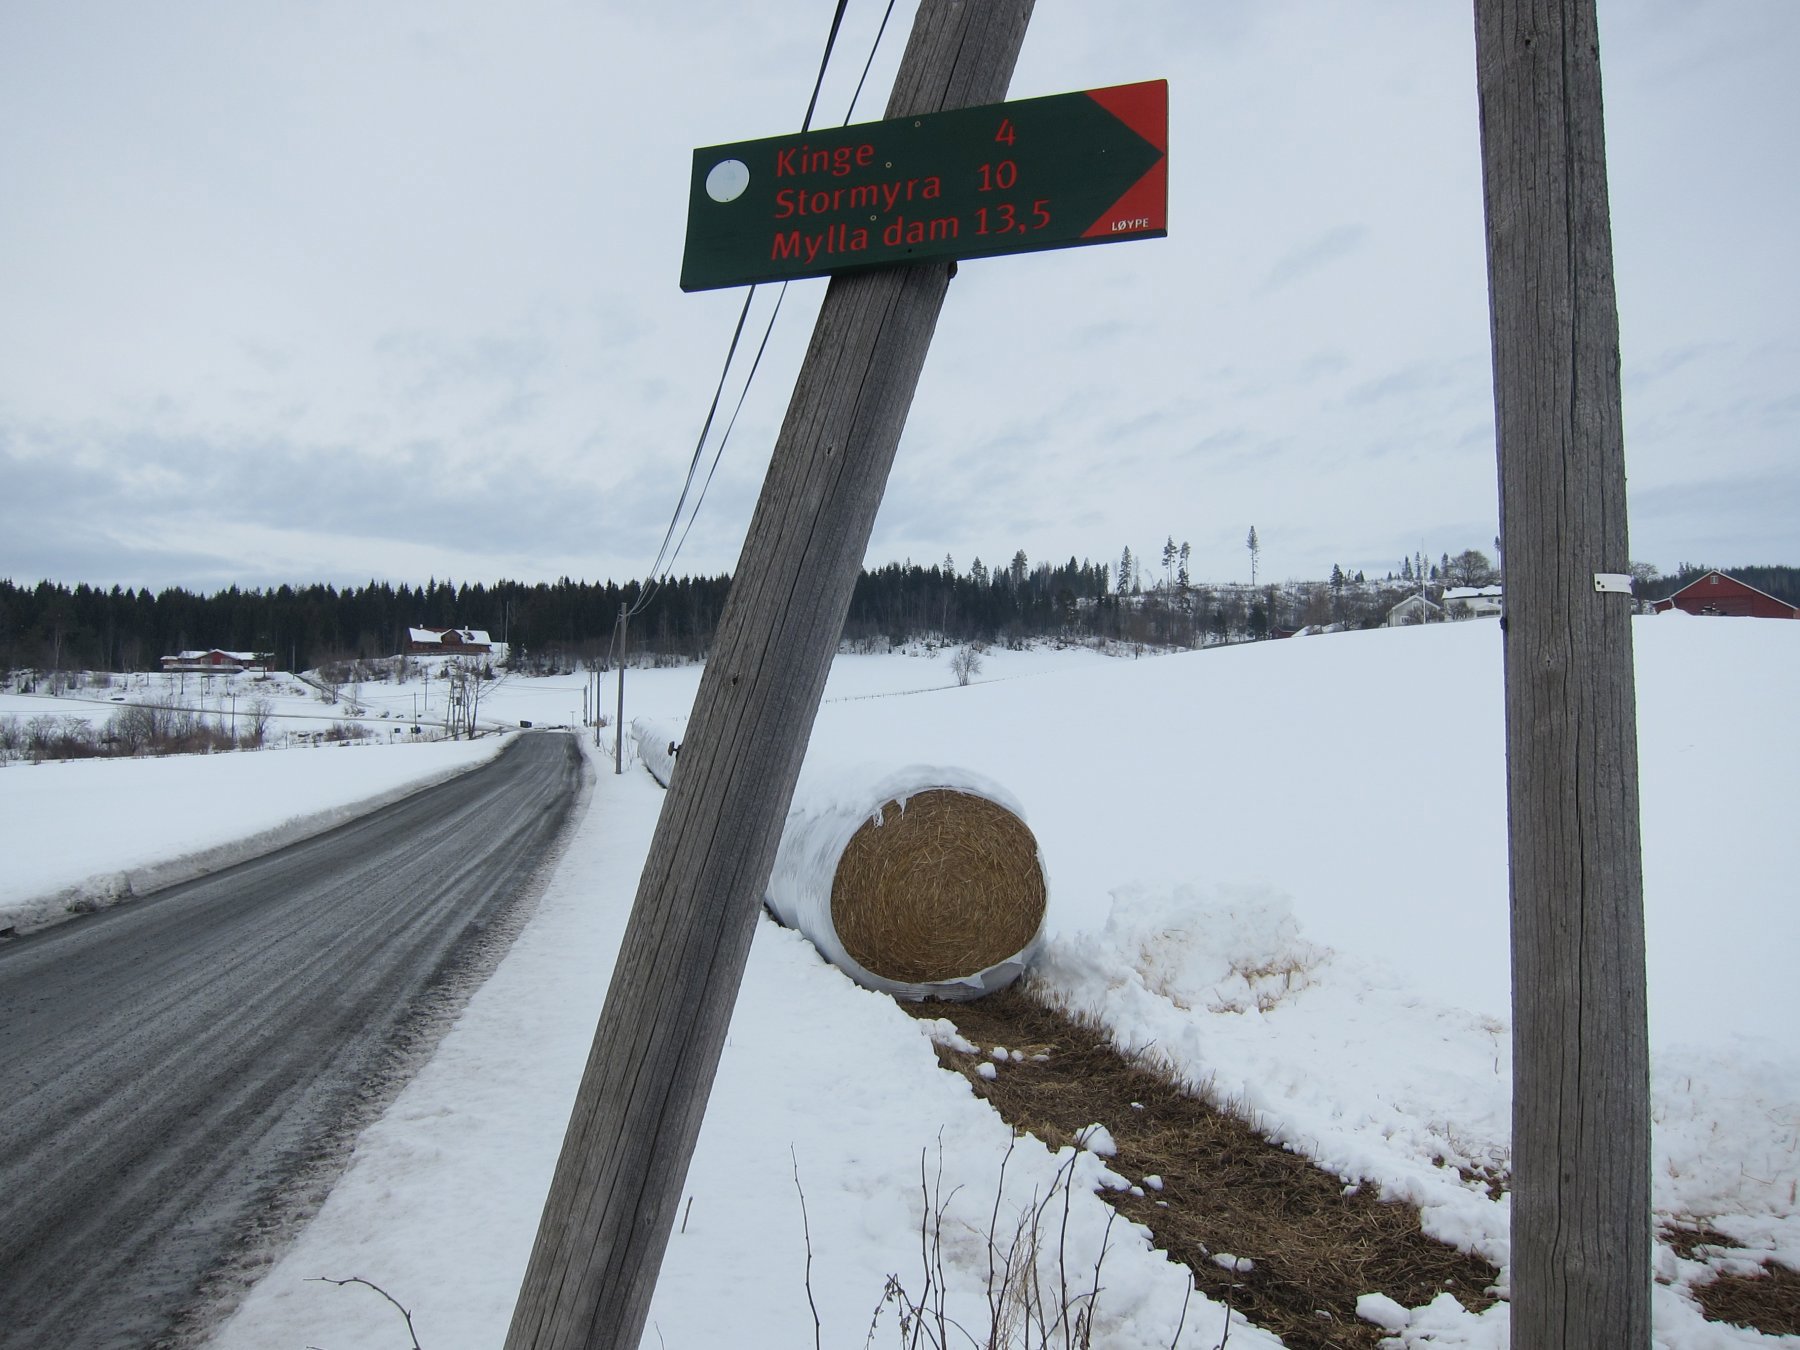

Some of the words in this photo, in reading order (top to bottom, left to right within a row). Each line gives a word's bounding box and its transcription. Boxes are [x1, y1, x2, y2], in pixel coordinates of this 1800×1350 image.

[776, 143, 875, 178] Kinge
[995, 119, 1015, 146] 4
[774, 174, 942, 219] Stormyra
[979, 159, 1018, 193] 10
[771, 222, 869, 264] Mylla
[883, 215, 959, 248] dam
[974, 199, 1052, 236] 13,5
[1111, 217, 1149, 232] LØYPE
